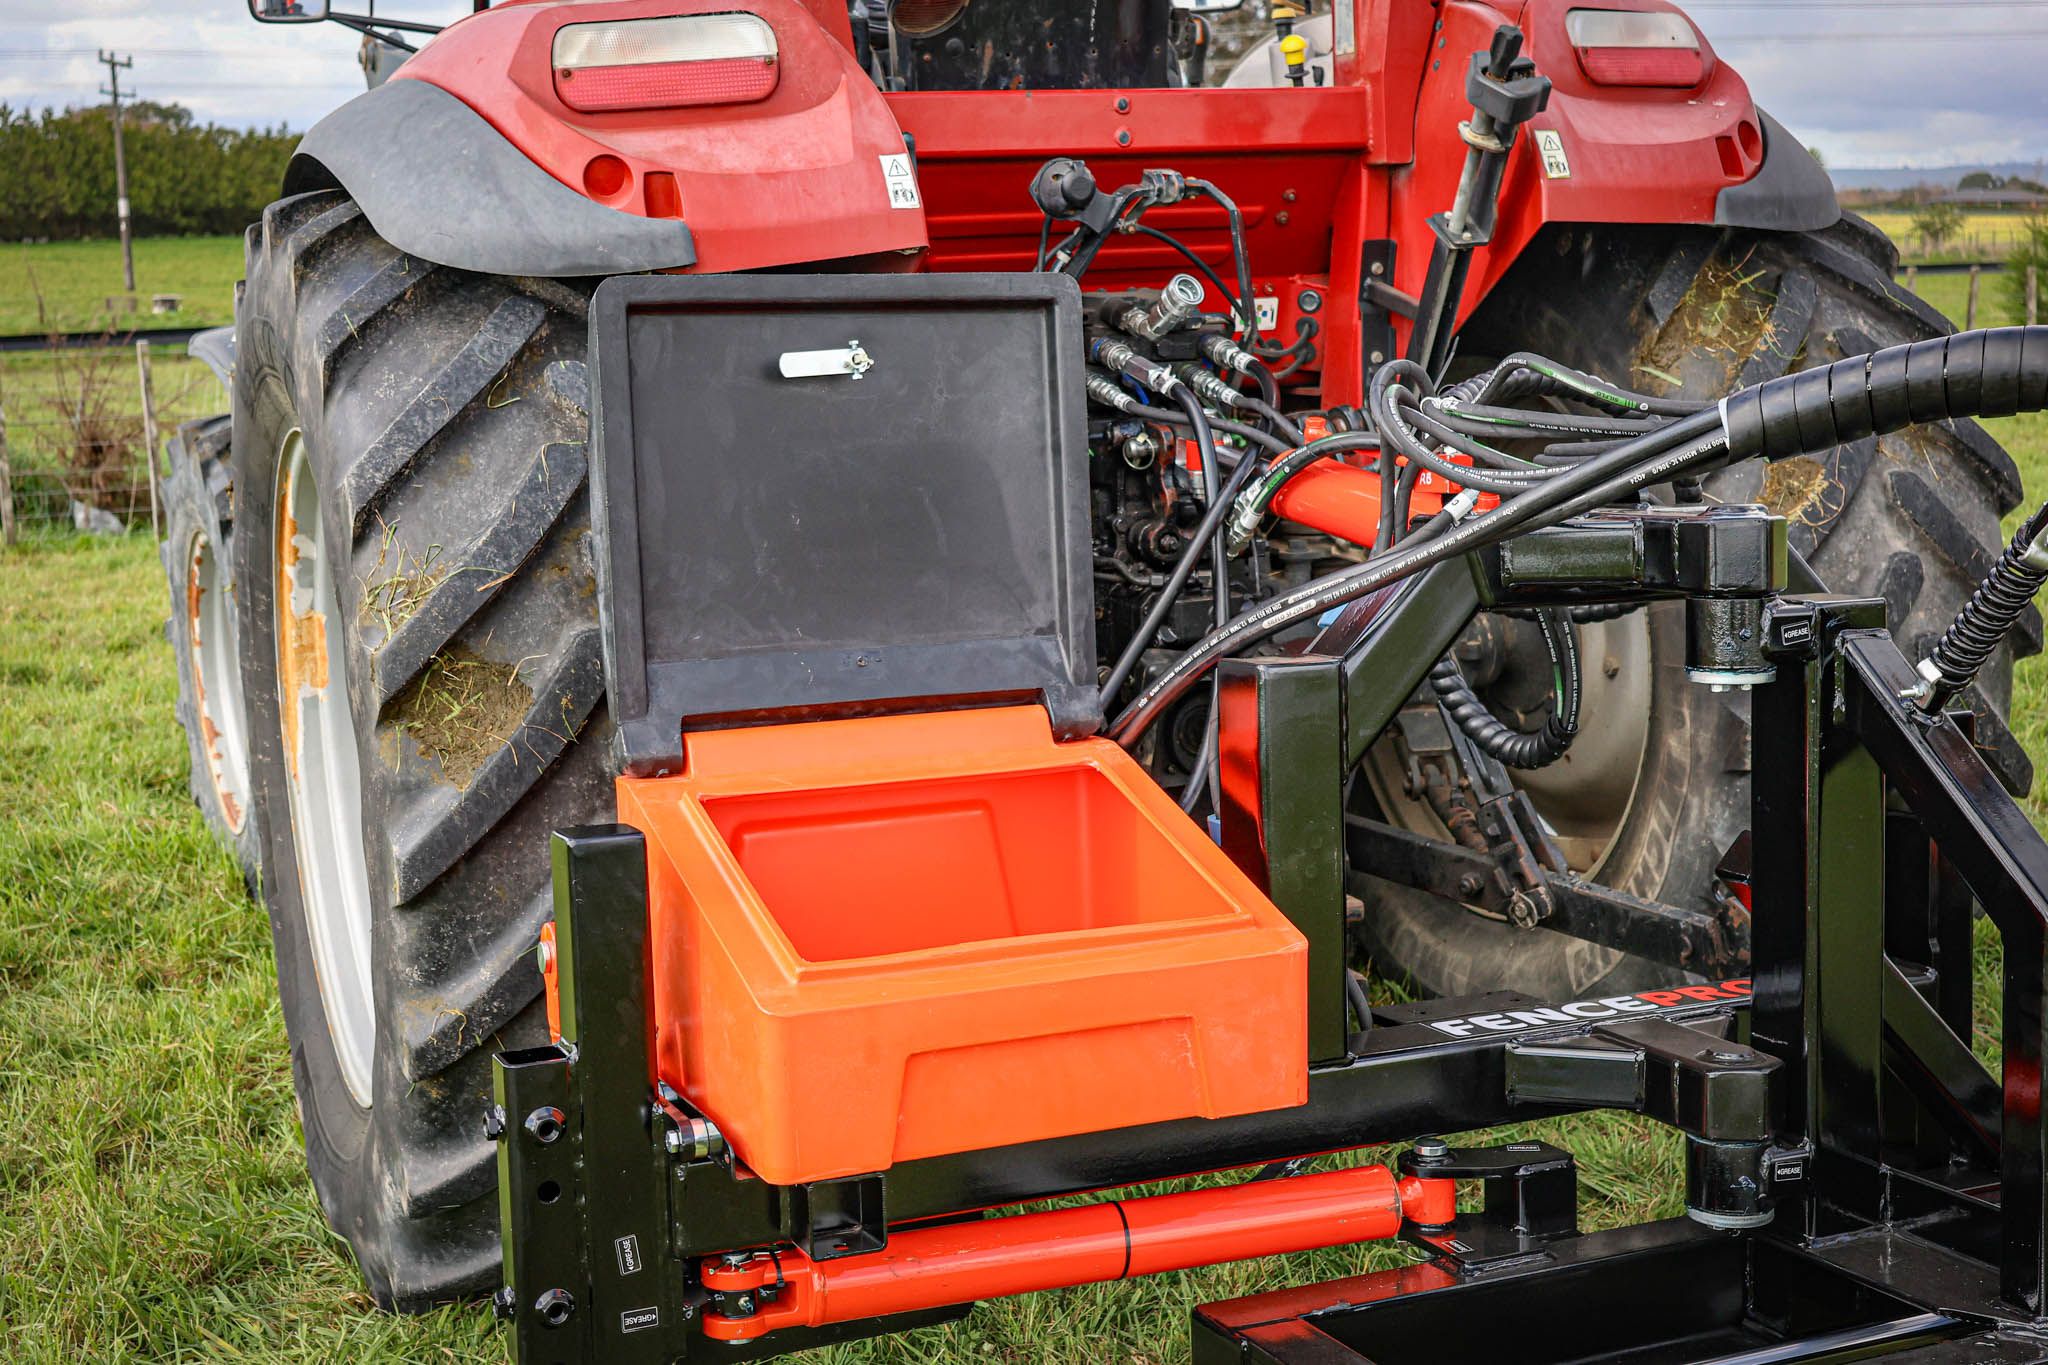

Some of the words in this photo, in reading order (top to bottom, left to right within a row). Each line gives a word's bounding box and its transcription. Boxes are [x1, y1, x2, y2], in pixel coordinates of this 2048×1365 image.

[1679, 448, 1698, 462] MSHA
[1630, 473, 1646, 485] 4Q24
[1787, 627, 1809, 639] GREASE
[1780, 1166, 1801, 1175] GREASE
[623, 1239, 634, 1267] GREASE
[625, 1314, 652, 1326] GREASE
